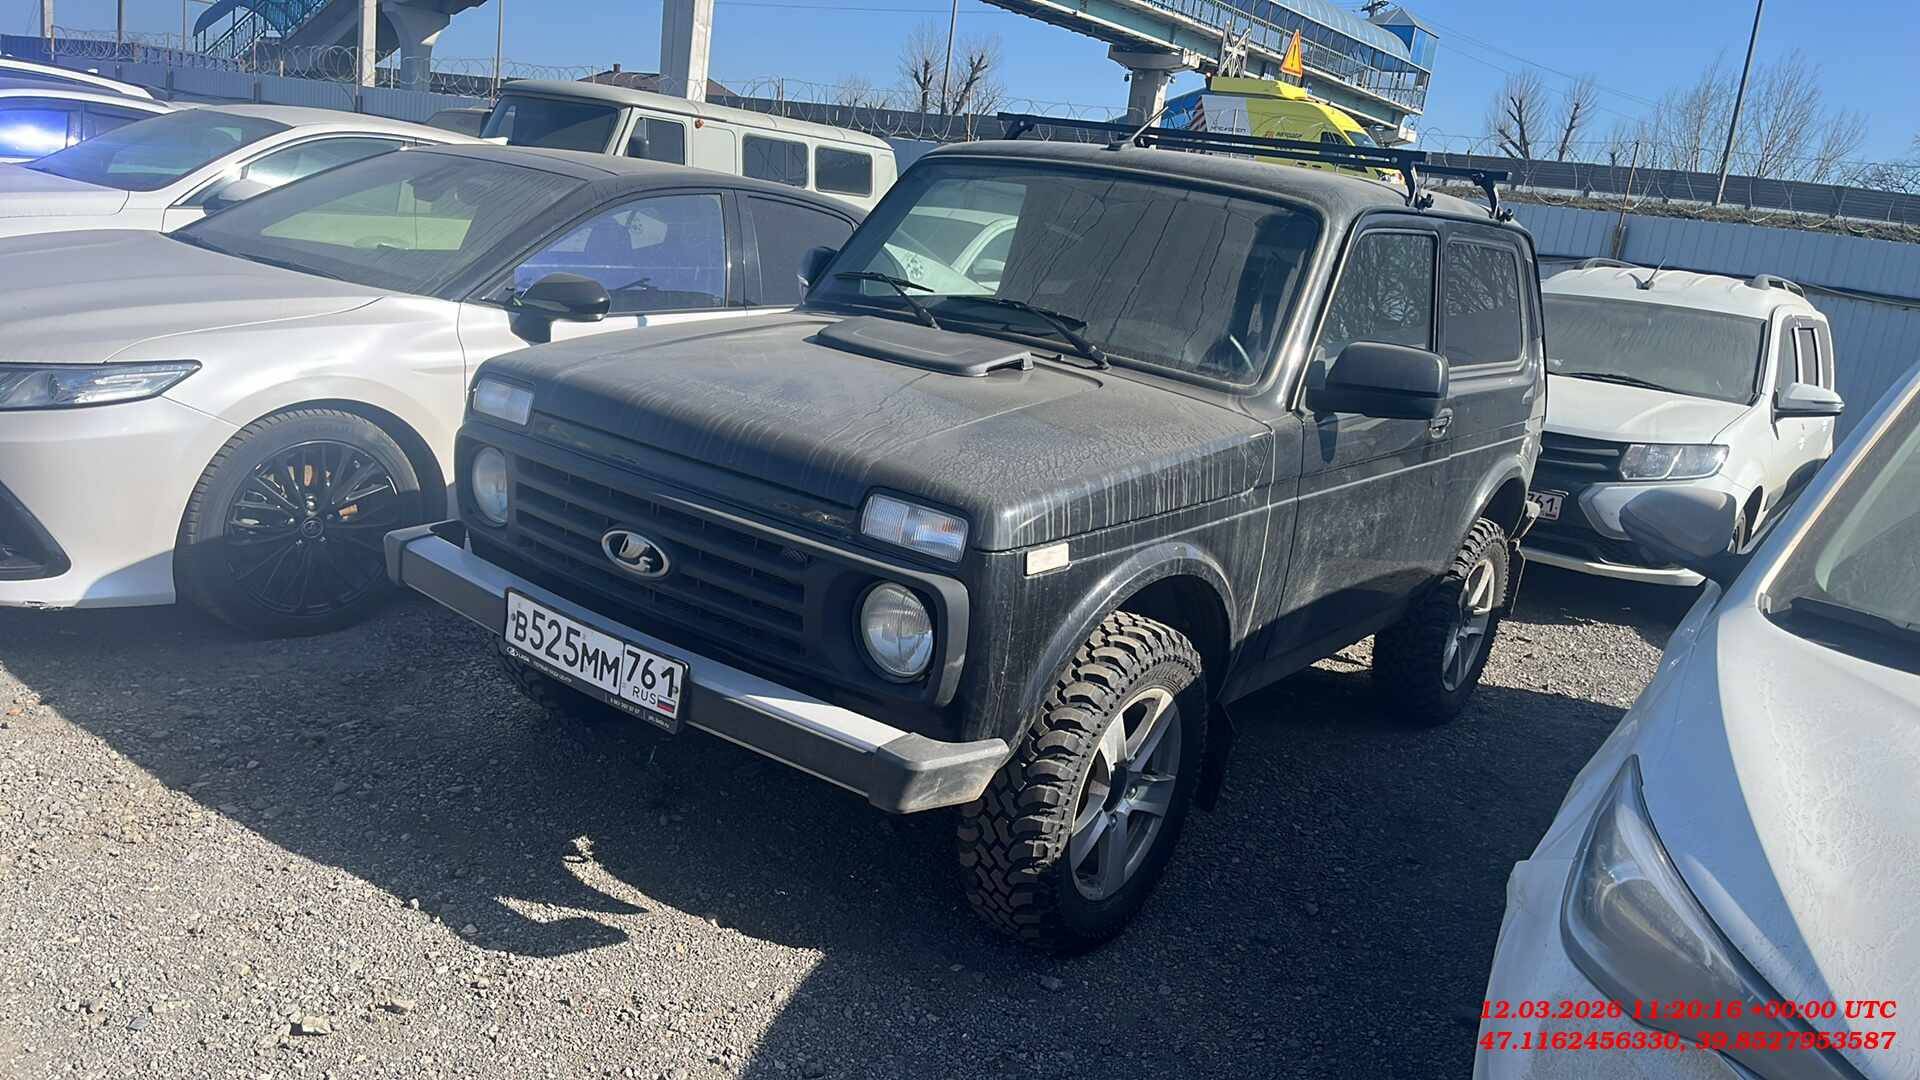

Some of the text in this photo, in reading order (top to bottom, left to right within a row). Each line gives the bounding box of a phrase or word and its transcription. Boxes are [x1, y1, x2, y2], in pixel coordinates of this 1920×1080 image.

[514, 610, 676, 698] В525ММ 761
[633, 686, 657, 705] RUS
